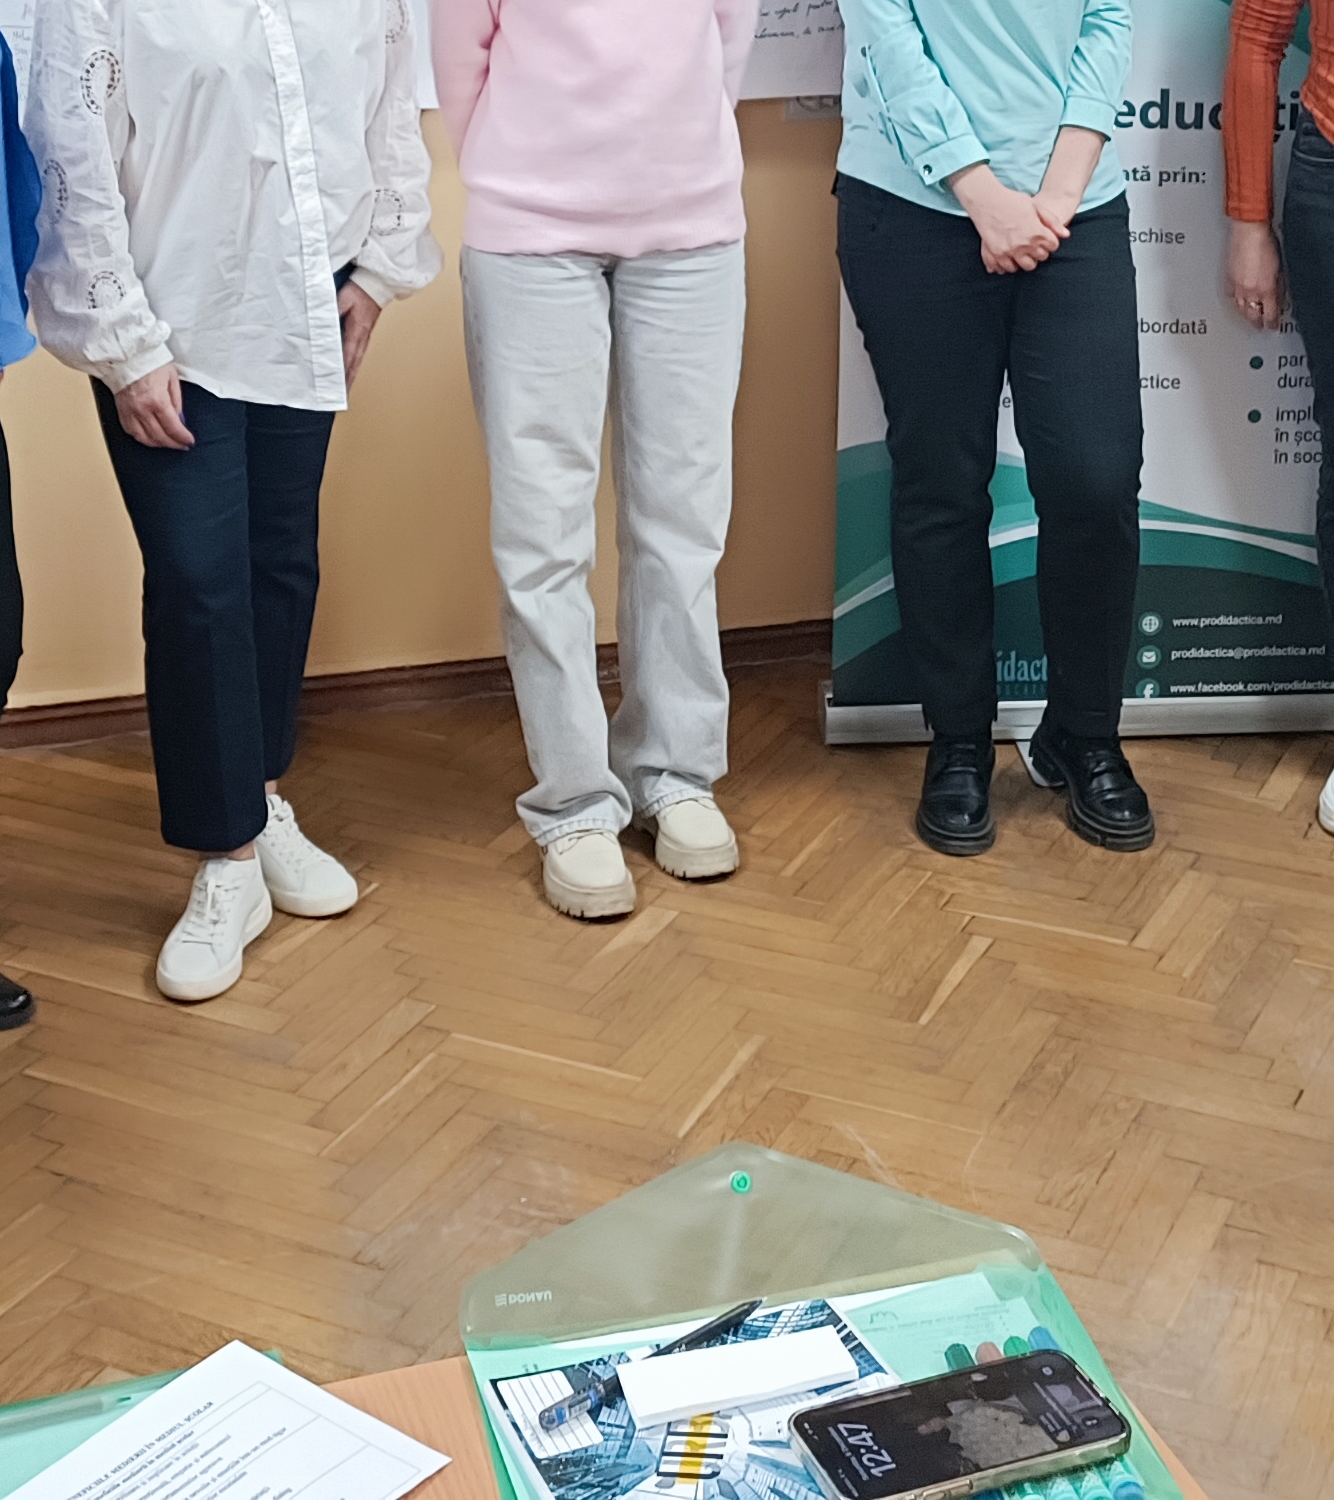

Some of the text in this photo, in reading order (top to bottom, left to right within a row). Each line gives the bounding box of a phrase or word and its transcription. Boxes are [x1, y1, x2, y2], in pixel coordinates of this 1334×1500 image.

[1157, 166, 1207, 188] prin:
[1129, 227, 1186, 245] schise
[1139, 317, 1208, 335] bordată
[1277, 354, 1308, 371] par
[1139, 373, 1181, 391] ctice
[1277, 372, 1315, 389] dura
[1275, 406, 1312, 425] impl
[1293, 430, 1323, 446] șco
[1293, 451, 1323, 465] soc
[1172, 613, 1283, 629] www.prodidactica.md
[1170, 643, 1326, 661] prodidactica@prodidactica.md
[996, 649, 1049, 682] idact
[836, 1421, 897, 1480] 12:47
